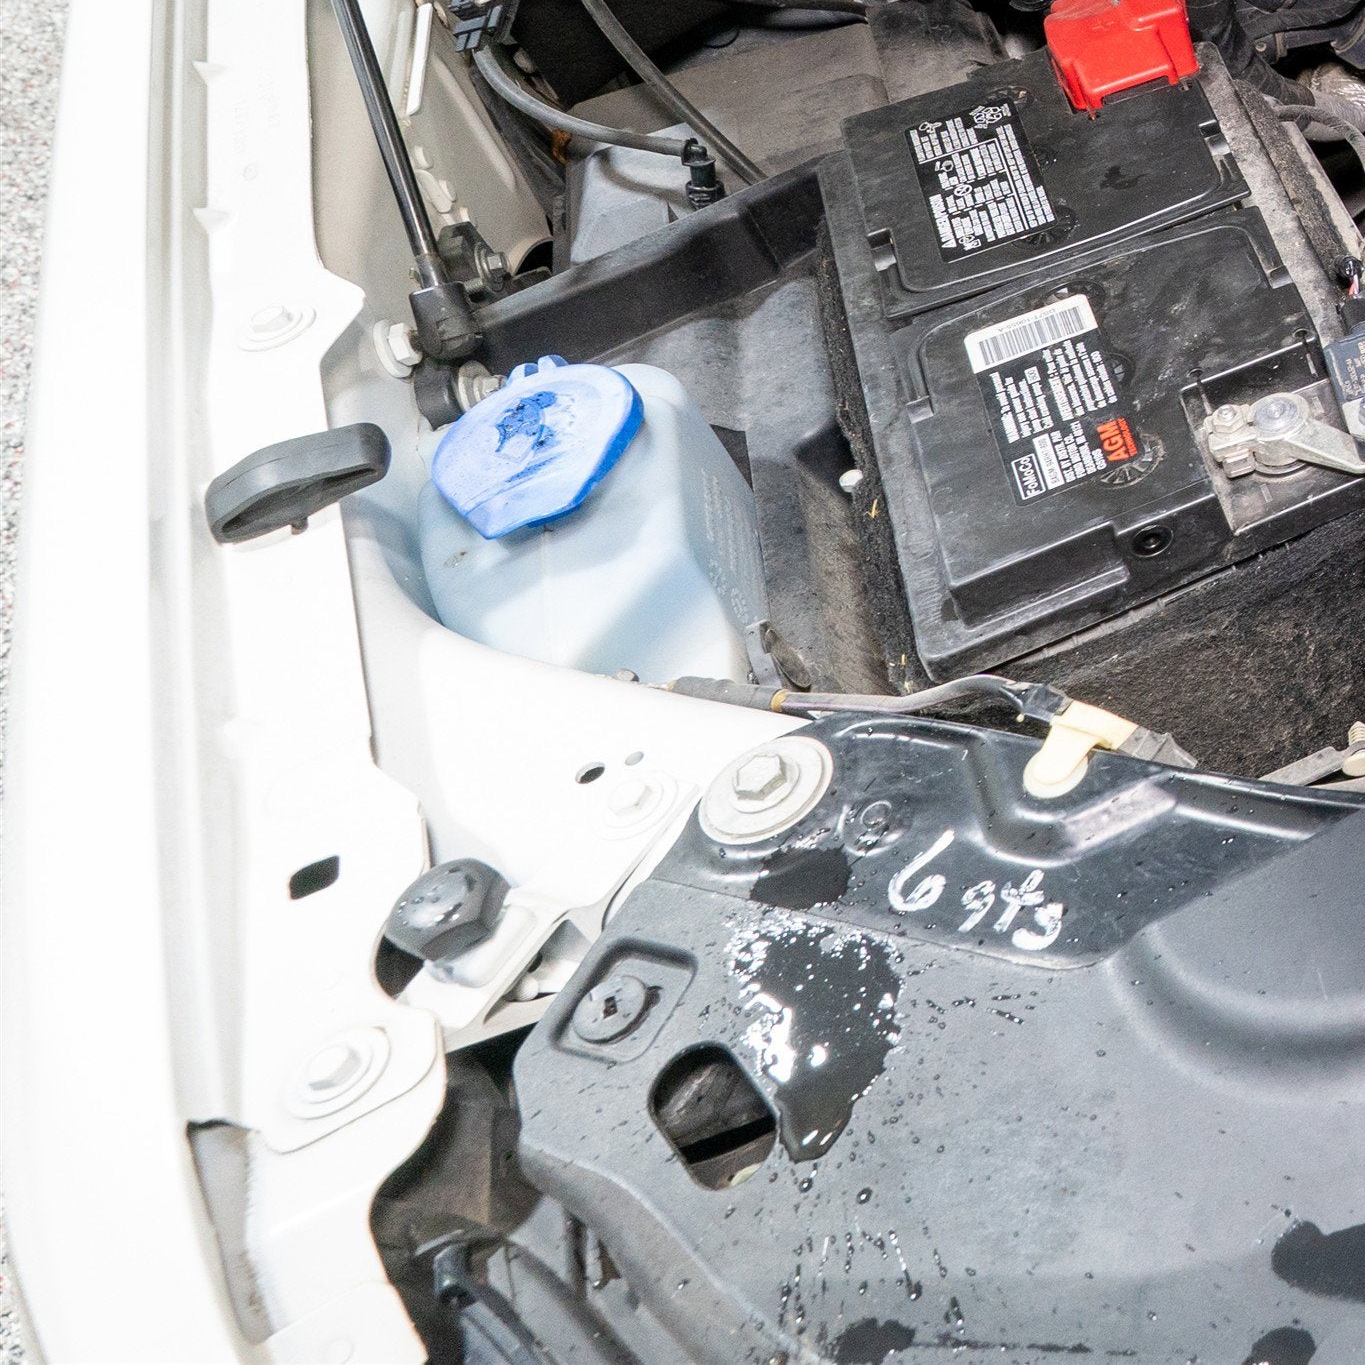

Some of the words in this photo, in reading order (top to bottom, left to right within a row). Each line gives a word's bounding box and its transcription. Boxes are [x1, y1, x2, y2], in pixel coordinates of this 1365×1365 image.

[1096, 419, 1129, 462] AGM
[1117, 416, 1138, 457] TECHNOLOGY
[1017, 456, 1040, 495] FoMoCo
[888, 829, 955, 912] 6
